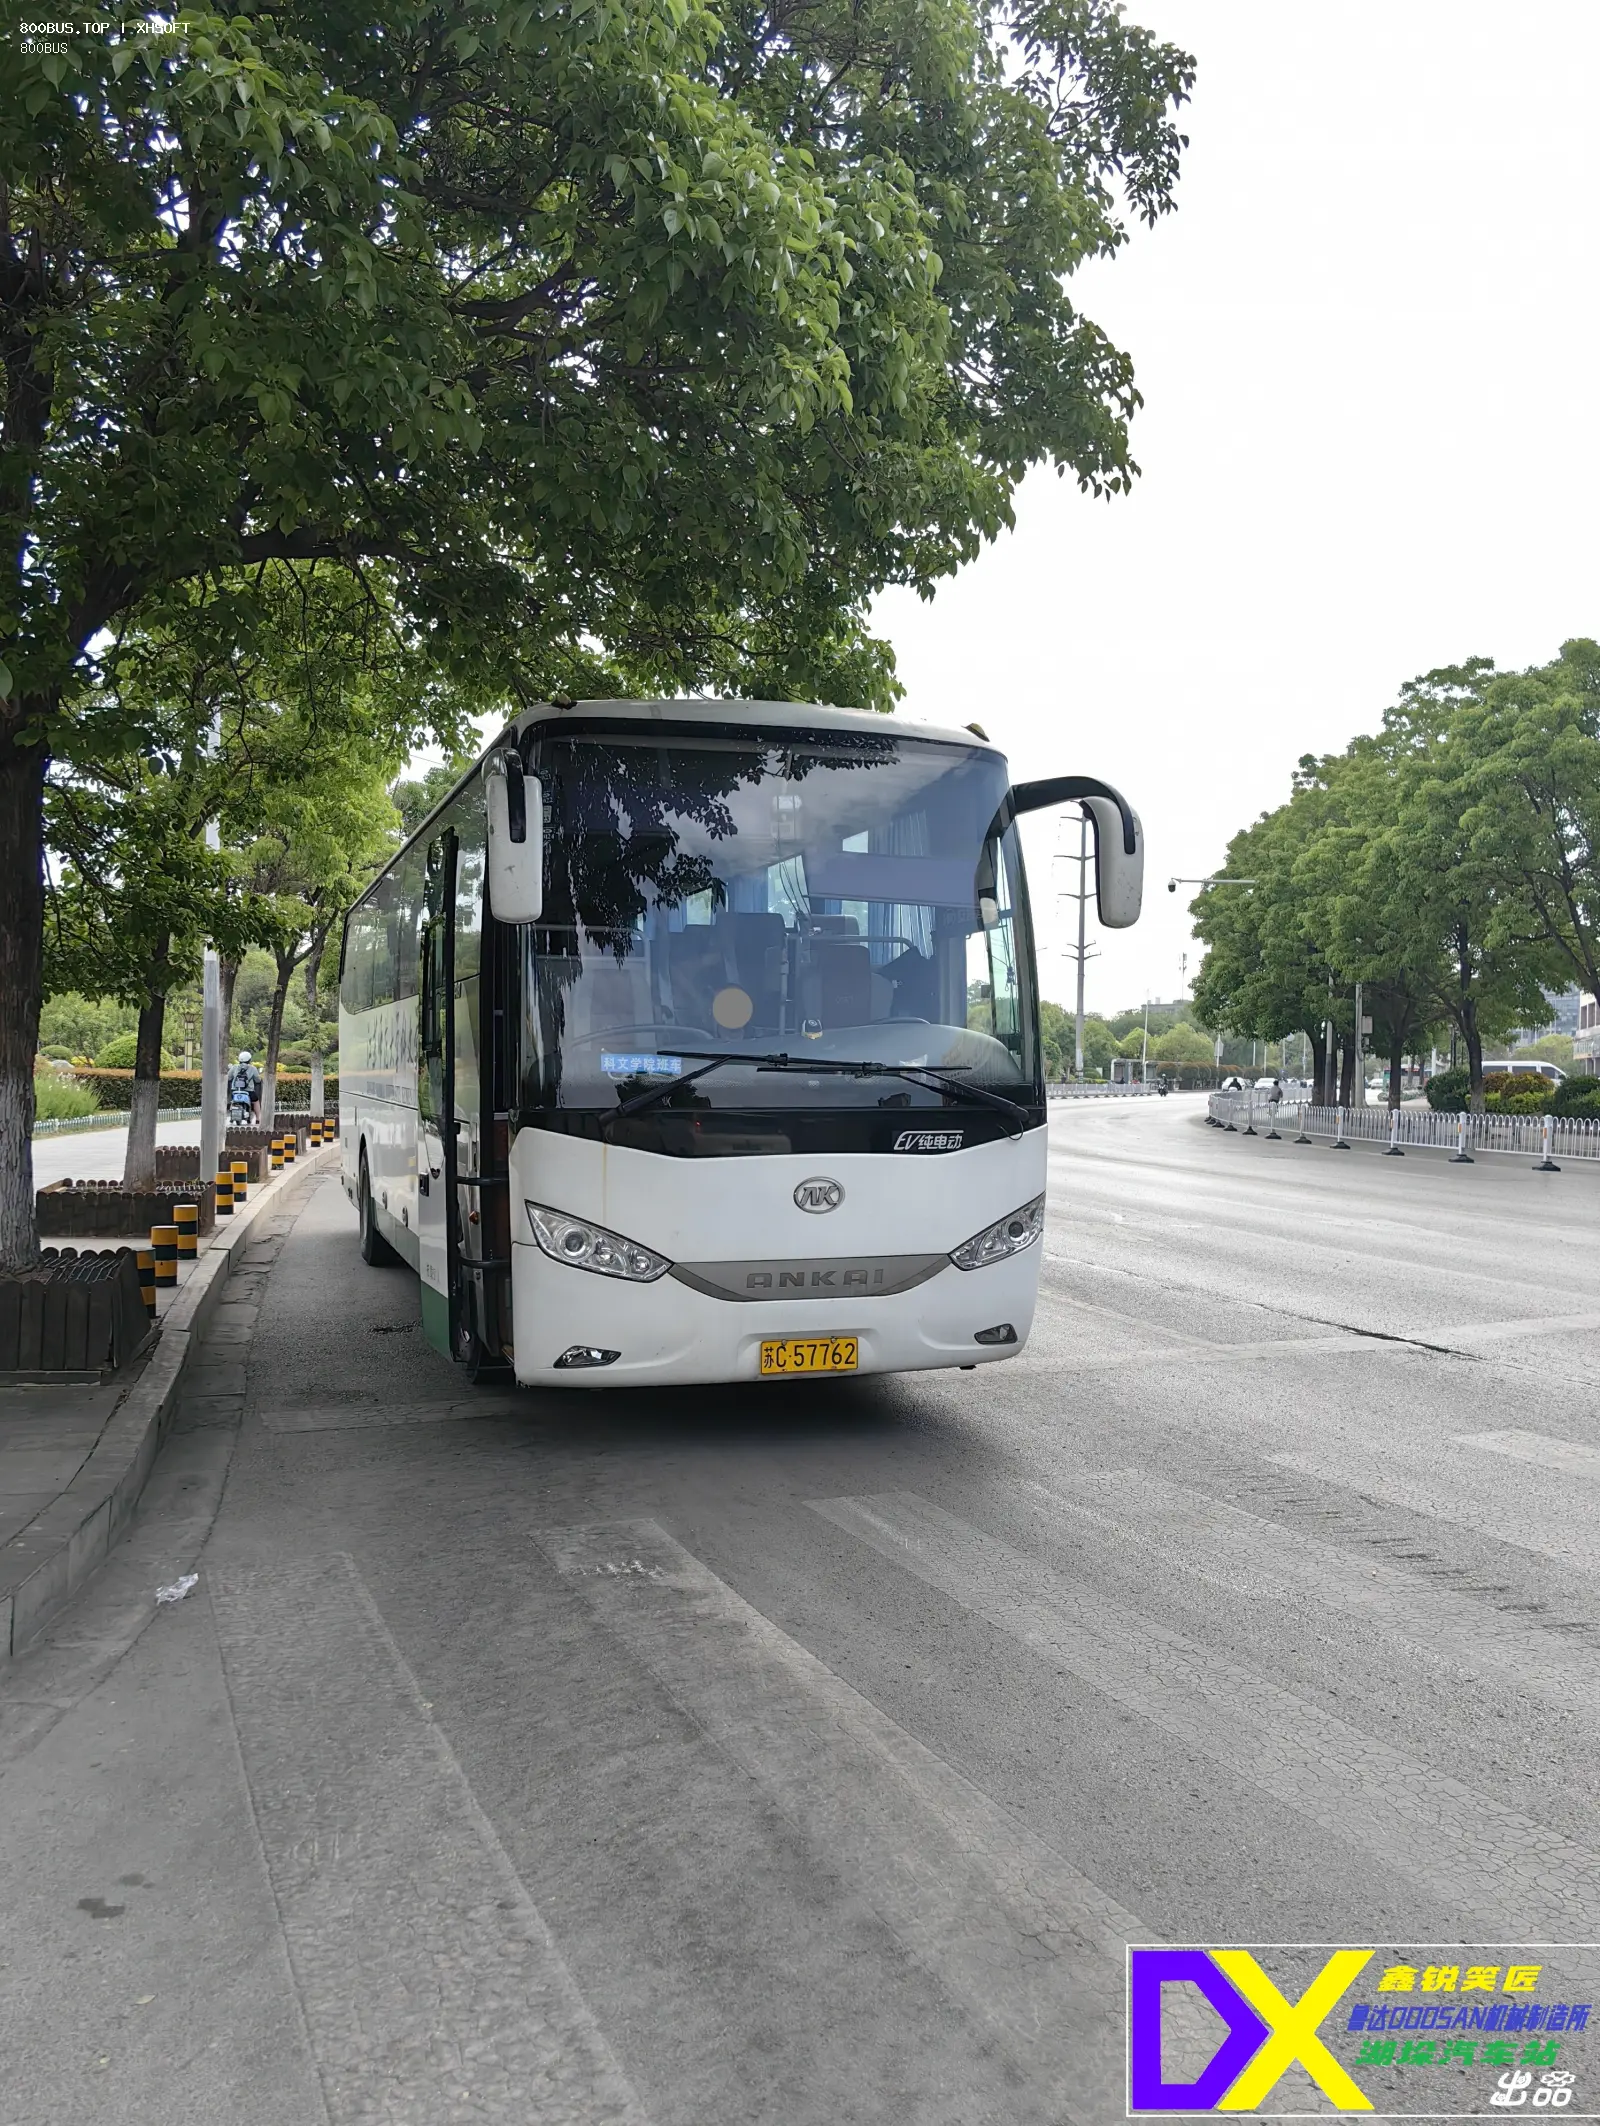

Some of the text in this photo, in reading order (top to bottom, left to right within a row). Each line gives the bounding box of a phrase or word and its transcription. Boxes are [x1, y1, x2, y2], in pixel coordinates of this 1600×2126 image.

[603, 1057, 681, 1072] 科文学院班车
[746, 1268, 884, 1289] ANKAI
